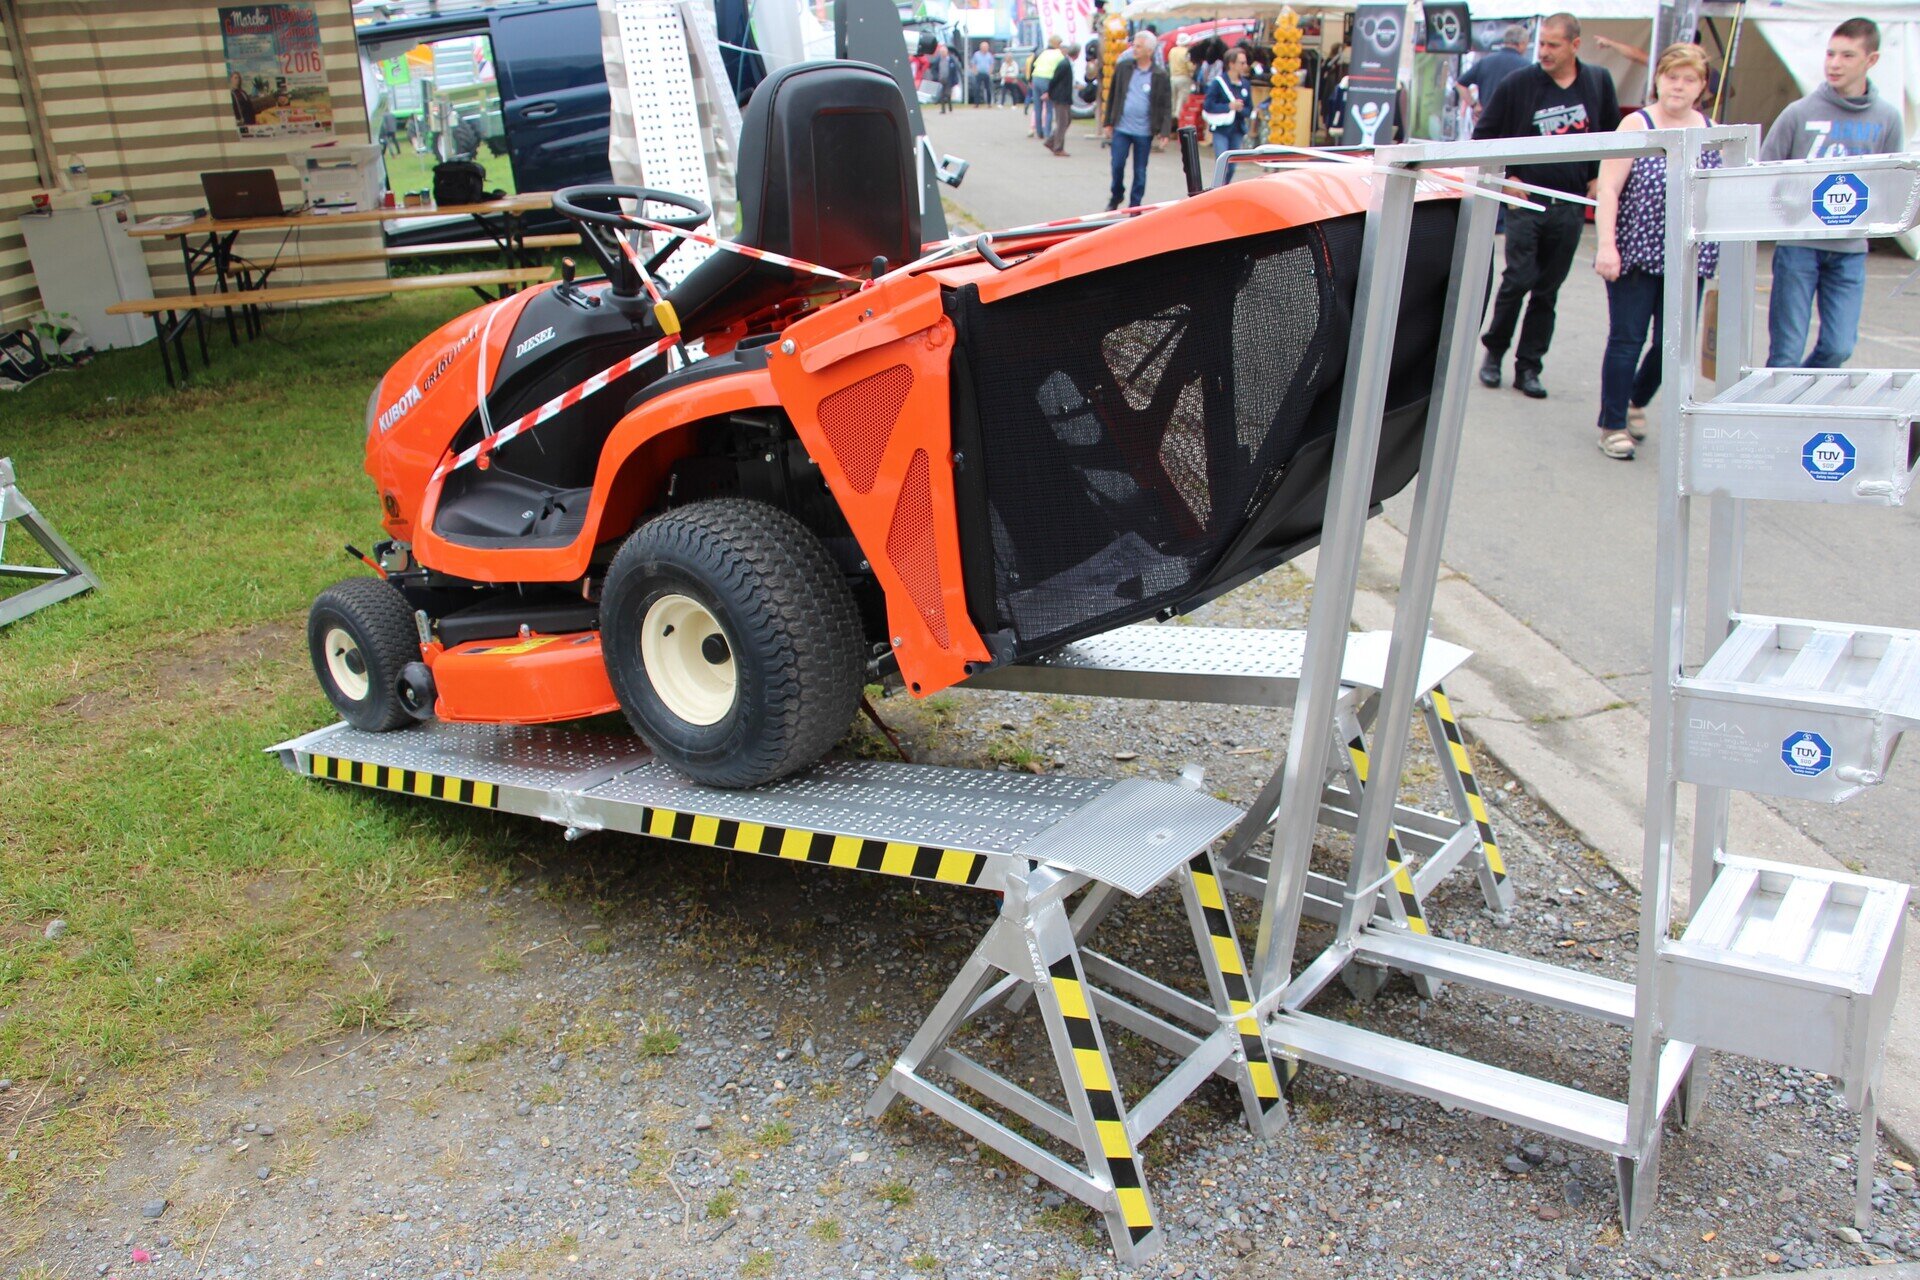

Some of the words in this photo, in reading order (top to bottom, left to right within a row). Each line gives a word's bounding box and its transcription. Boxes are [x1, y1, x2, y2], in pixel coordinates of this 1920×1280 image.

[283, 51, 322, 75] 2016
[515, 326, 556, 359] DIESEL
[378, 383, 423, 435] KUBOTA
[1703, 428, 1760, 440] DIMA
[1689, 718, 1745, 735] DIMA
